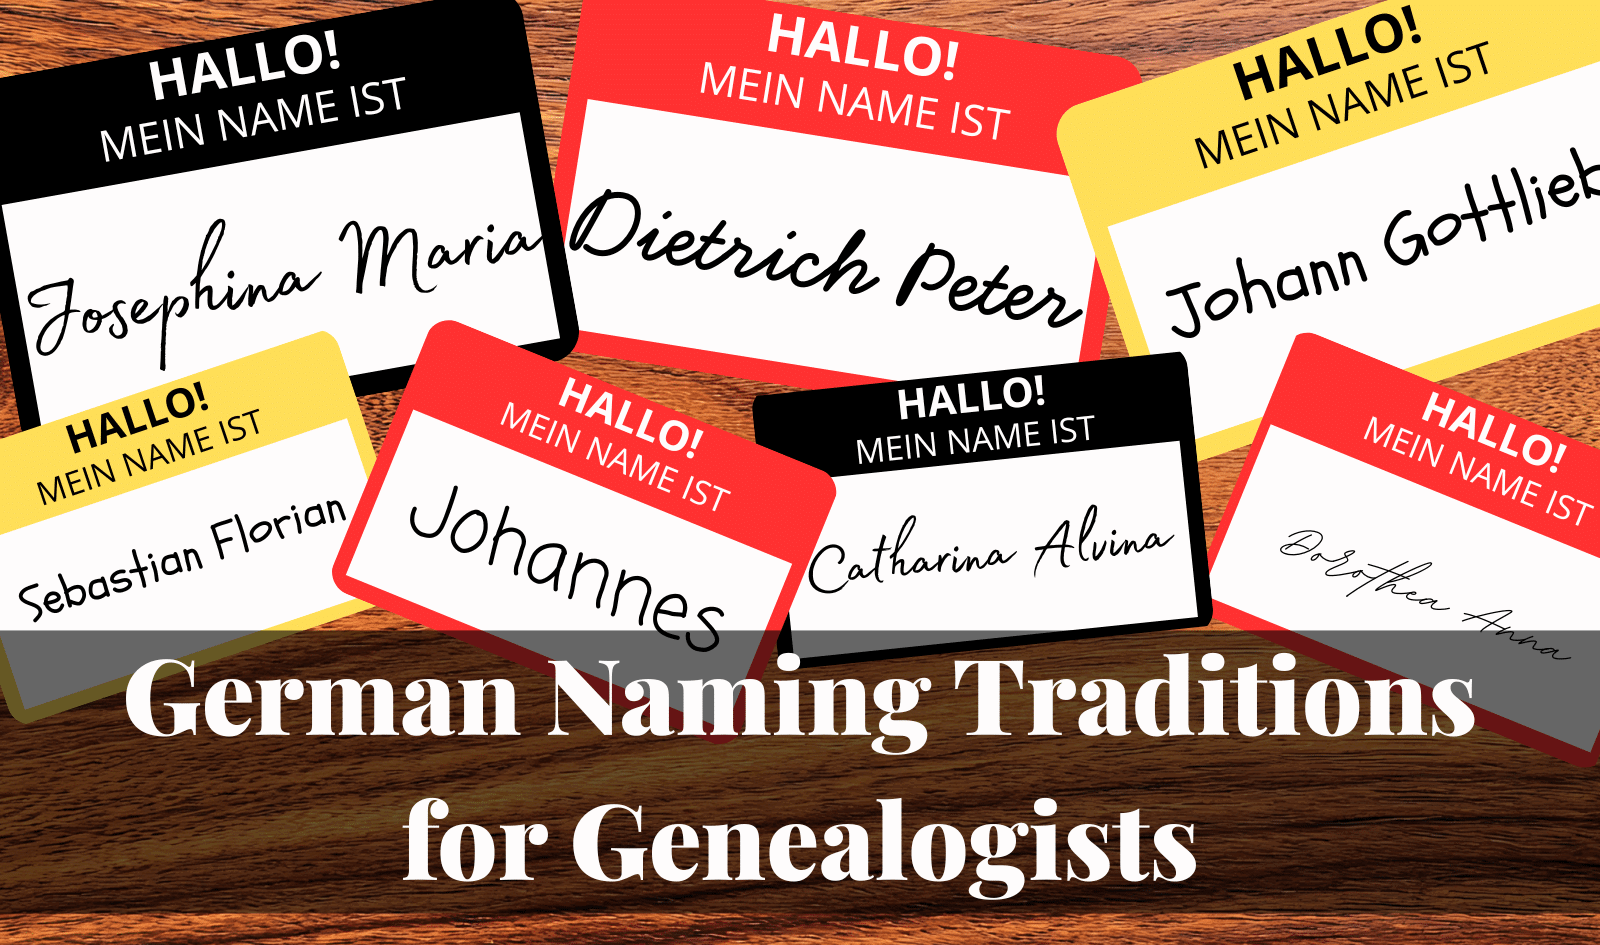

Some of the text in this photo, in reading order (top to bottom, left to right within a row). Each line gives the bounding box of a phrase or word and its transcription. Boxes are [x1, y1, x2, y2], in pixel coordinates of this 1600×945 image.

[149, 29, 340, 101] HALLO!
[767, 12, 959, 81] HALLO!
[1232, 4, 1422, 101] HALLO!
[100, 76, 406, 162] MEIN NAME IST
[699, 61, 1011, 141] MEIN NAME IST
[1194, 40, 1490, 169] MEIN NAME IST
[27, 218, 543, 372] Josephina Maria
[568, 188, 1084, 329] Dietrich Peter
[1165, 251, 1368, 339] Johann
[65, 381, 210, 454] HALLO!
[558, 376, 704, 460] HALLO!
[856, 415, 1095, 465] MEIN NAME IST
[897, 374, 1046, 421] HALLO!
[1421, 391, 1568, 474] HALLO!
[36, 408, 261, 506] MEIN NAME IST
[500, 401, 732, 512] MEIN NAME IST
[1363, 416, 1595, 527] MEIN NAME IST
[18, 500, 347, 623] Sebastian Florian
[409, 485, 725, 653] Johannes
[808, 504, 1175, 594] Catharina Alvina
[1279, 529, 1572, 661] Dorothea Anna
